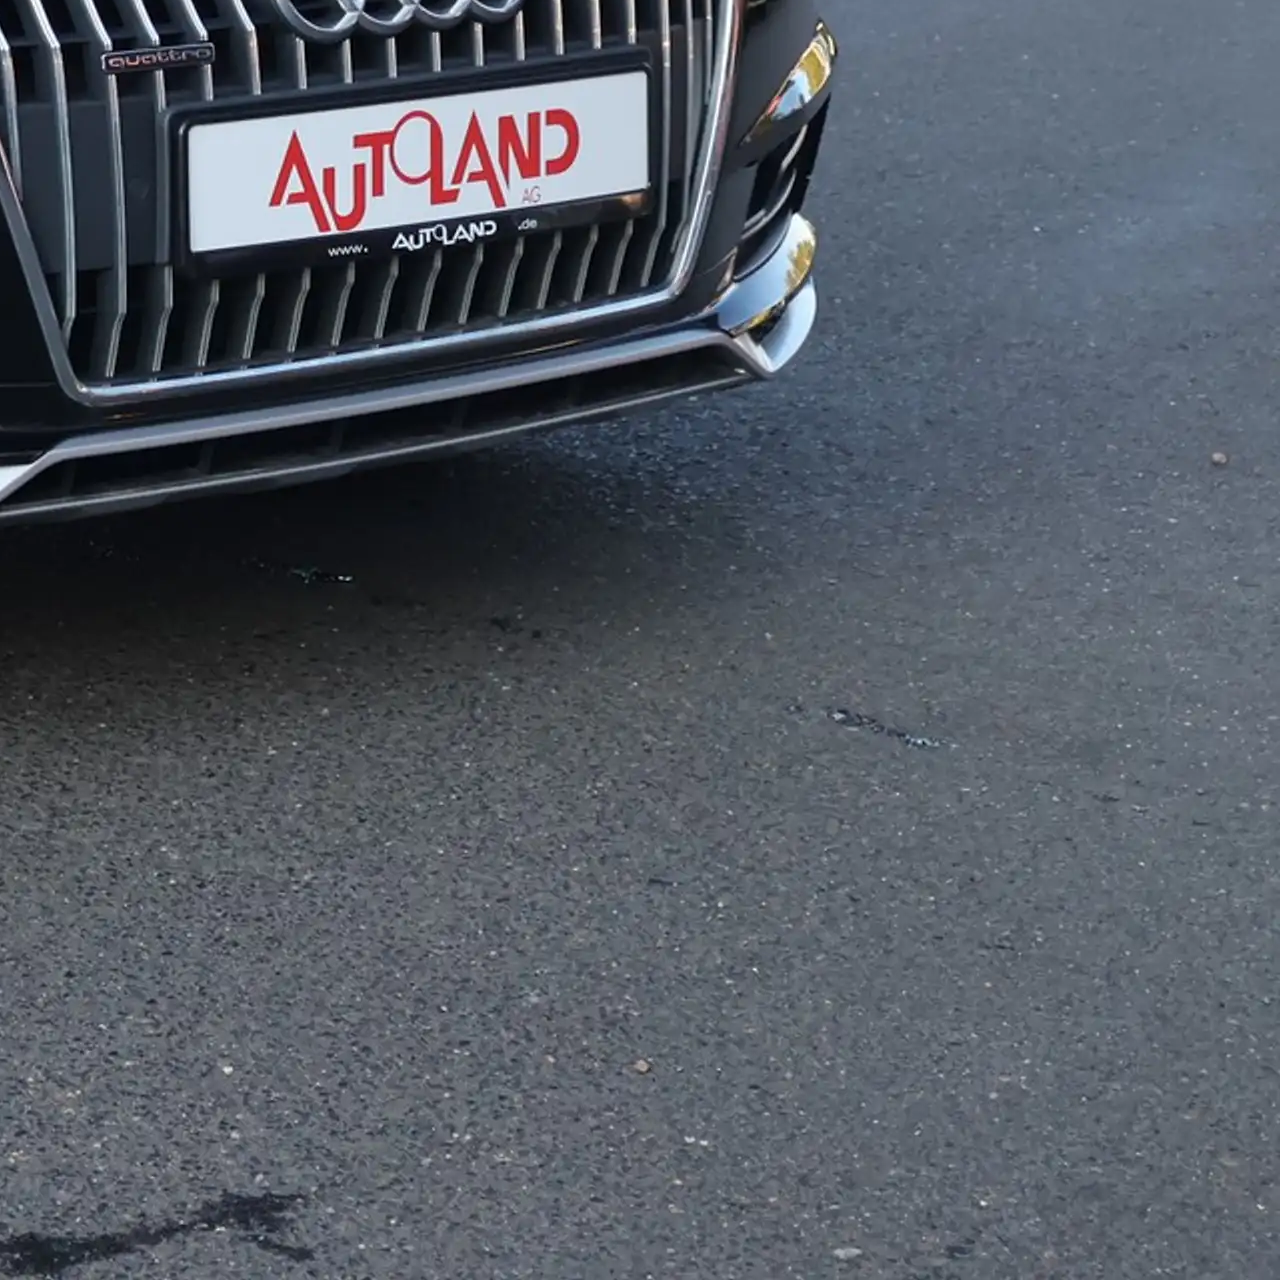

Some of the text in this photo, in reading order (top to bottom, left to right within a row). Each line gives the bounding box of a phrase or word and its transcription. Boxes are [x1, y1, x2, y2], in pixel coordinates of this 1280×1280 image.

[108, 48, 212, 68] quattro
[269, 109, 580, 233] AUTOLAND
[522, 185, 542, 204] AG
[391, 220, 498, 252] AUTOLAND
